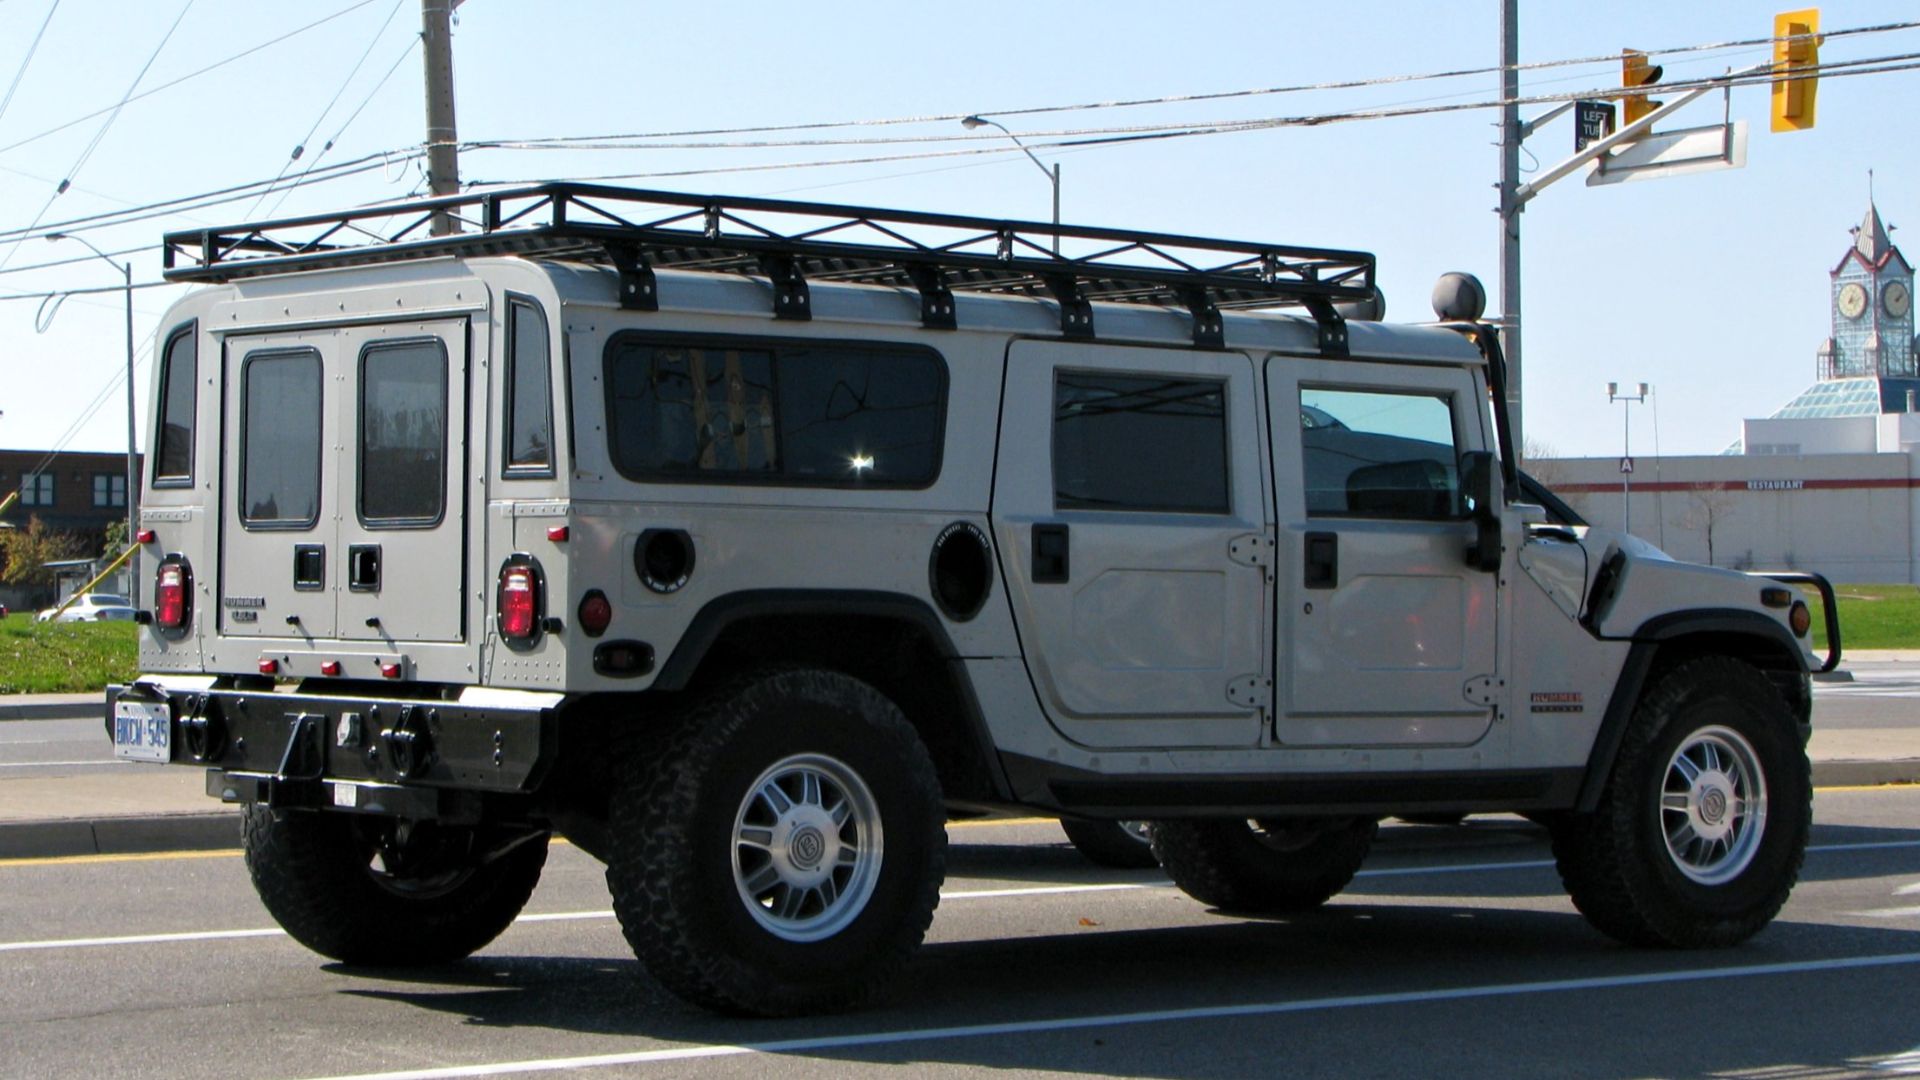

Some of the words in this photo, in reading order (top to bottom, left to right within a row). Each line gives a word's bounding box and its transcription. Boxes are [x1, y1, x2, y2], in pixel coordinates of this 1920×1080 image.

[1583, 110, 1608, 122] LEFT
[1621, 458, 1633, 472] A
[1747, 480, 1803, 489] RESTAURANT
[148, 718, 168, 748] 545
